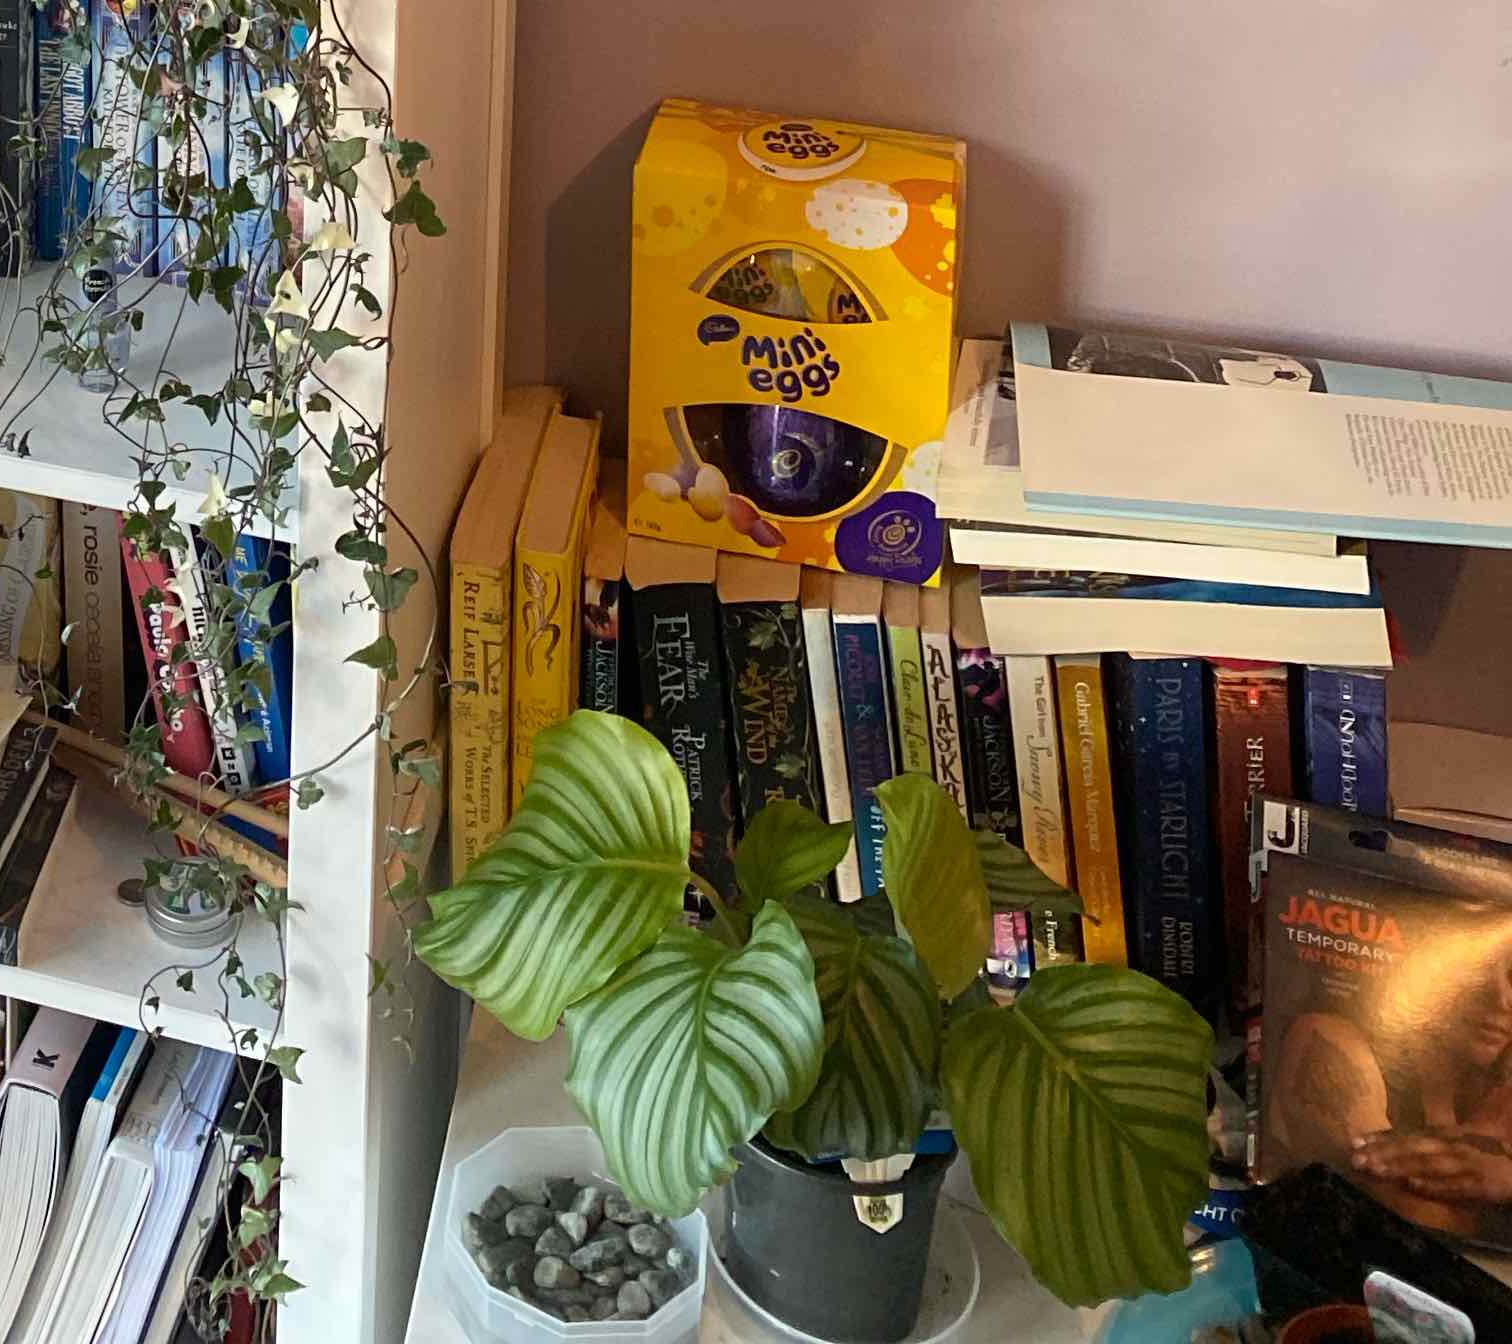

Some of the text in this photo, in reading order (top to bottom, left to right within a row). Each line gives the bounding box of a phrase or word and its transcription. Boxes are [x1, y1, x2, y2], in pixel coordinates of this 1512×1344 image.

[763, 130, 831, 145] Mini
[766, 142, 840, 160] eggs
[742, 327, 827, 369] Mini
[748, 353, 841, 403] eggs
[82, 525, 101, 587] rosie
[463, 580, 480, 620] REIF
[653, 612, 691, 712] FEAR
[743, 681, 772, 765] WIND
[926, 643, 966, 809] ALASKA
[1074, 681, 1095, 738] Gabriel
[1155, 677, 1185, 744] PARIS
[687, 731, 707, 801] PATRICK
[982, 714, 1012, 804] JACKSON
[1338, 709, 1359, 812] LOODHOUND
[479, 764, 492, 824] SELECTED
[1159, 779, 1190, 901] STARLIGHT
[1046, 920, 1060, 960] French
[1278, 894, 1405, 949] JAGUA
[1286, 927, 1394, 964] TEMPORARY
[1297, 948, 1359, 973] TATTOO
